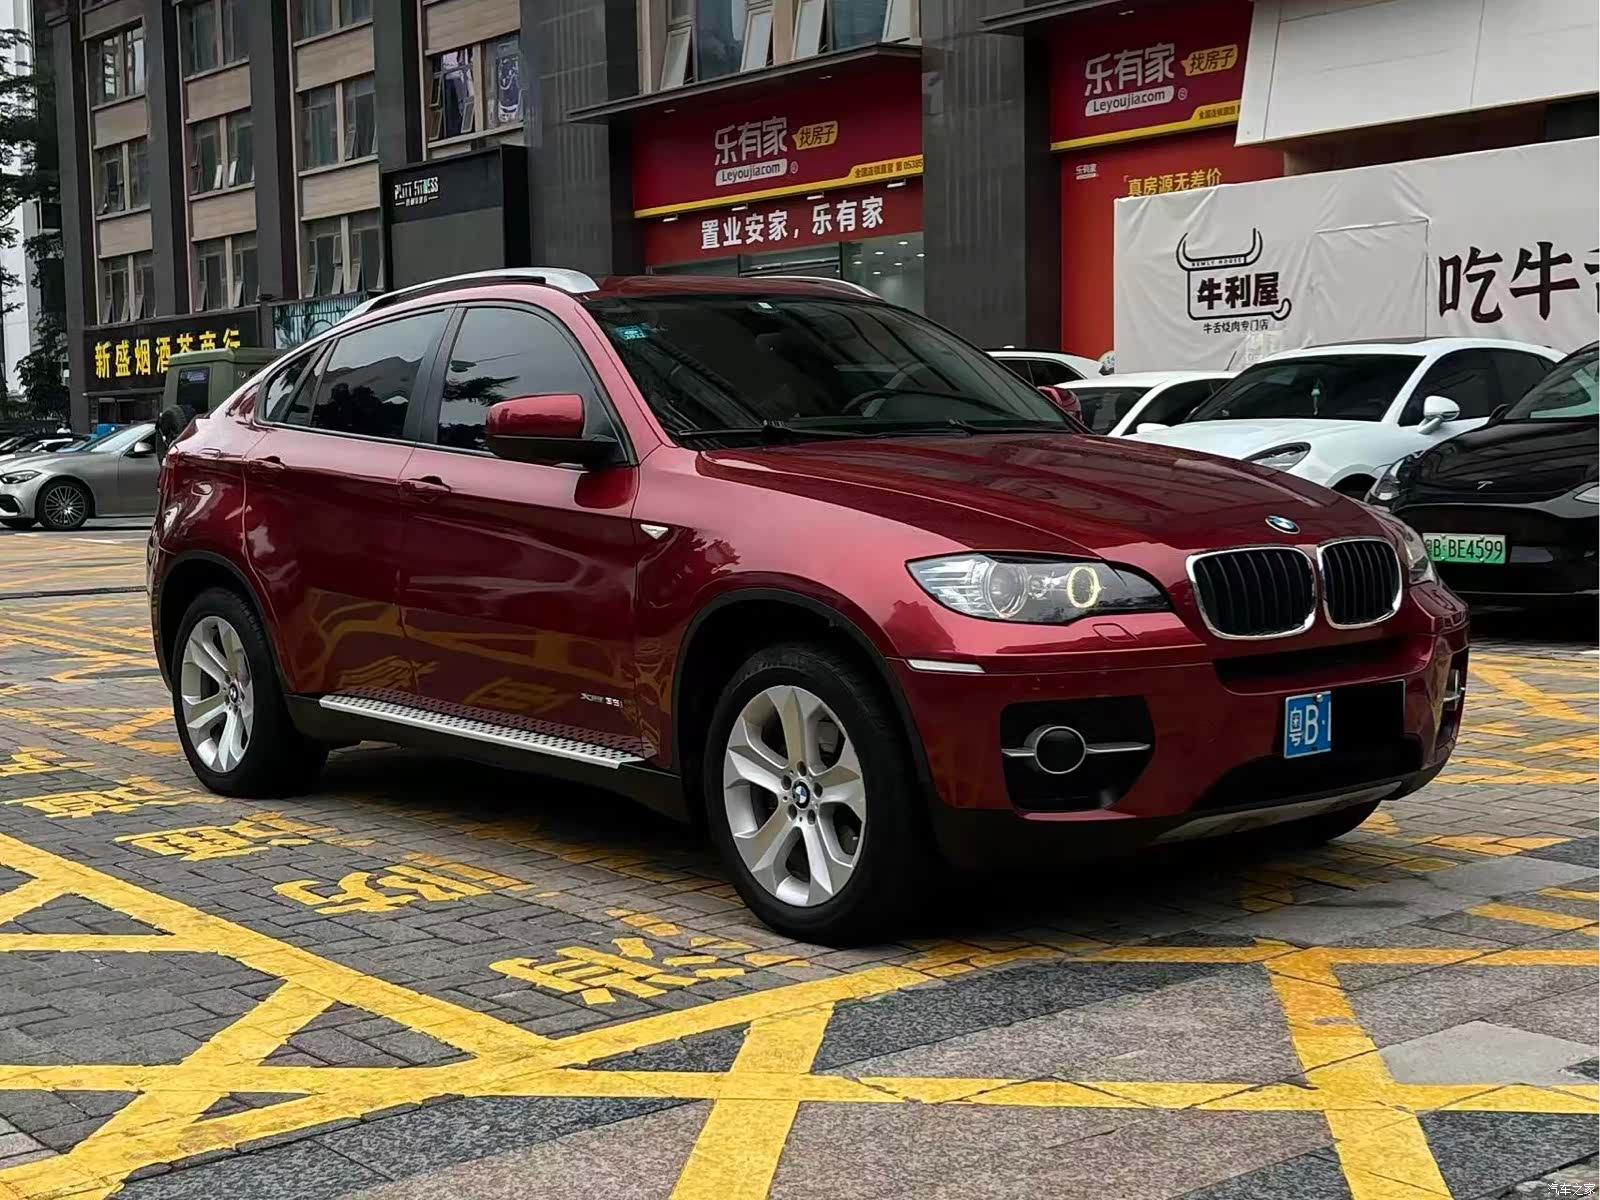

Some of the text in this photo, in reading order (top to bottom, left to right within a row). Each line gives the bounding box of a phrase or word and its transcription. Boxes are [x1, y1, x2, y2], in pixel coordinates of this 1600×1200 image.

[1084, 42, 1176, 97] 乐有家
[1190, 50, 1235, 74] 找房子
[1093, 90, 1165, 113] Leyoujia.com
[714, 116, 788, 166] 乐有家
[799, 125, 836, 148] 找房子
[722, 162, 781, 183] Leyoujia.com
[1197, 271, 1279, 311] 牛利屋
[1439, 241, 1599, 323] 吃牛
[1203, 319, 1268, 334] 牛舌烧肉专门店
